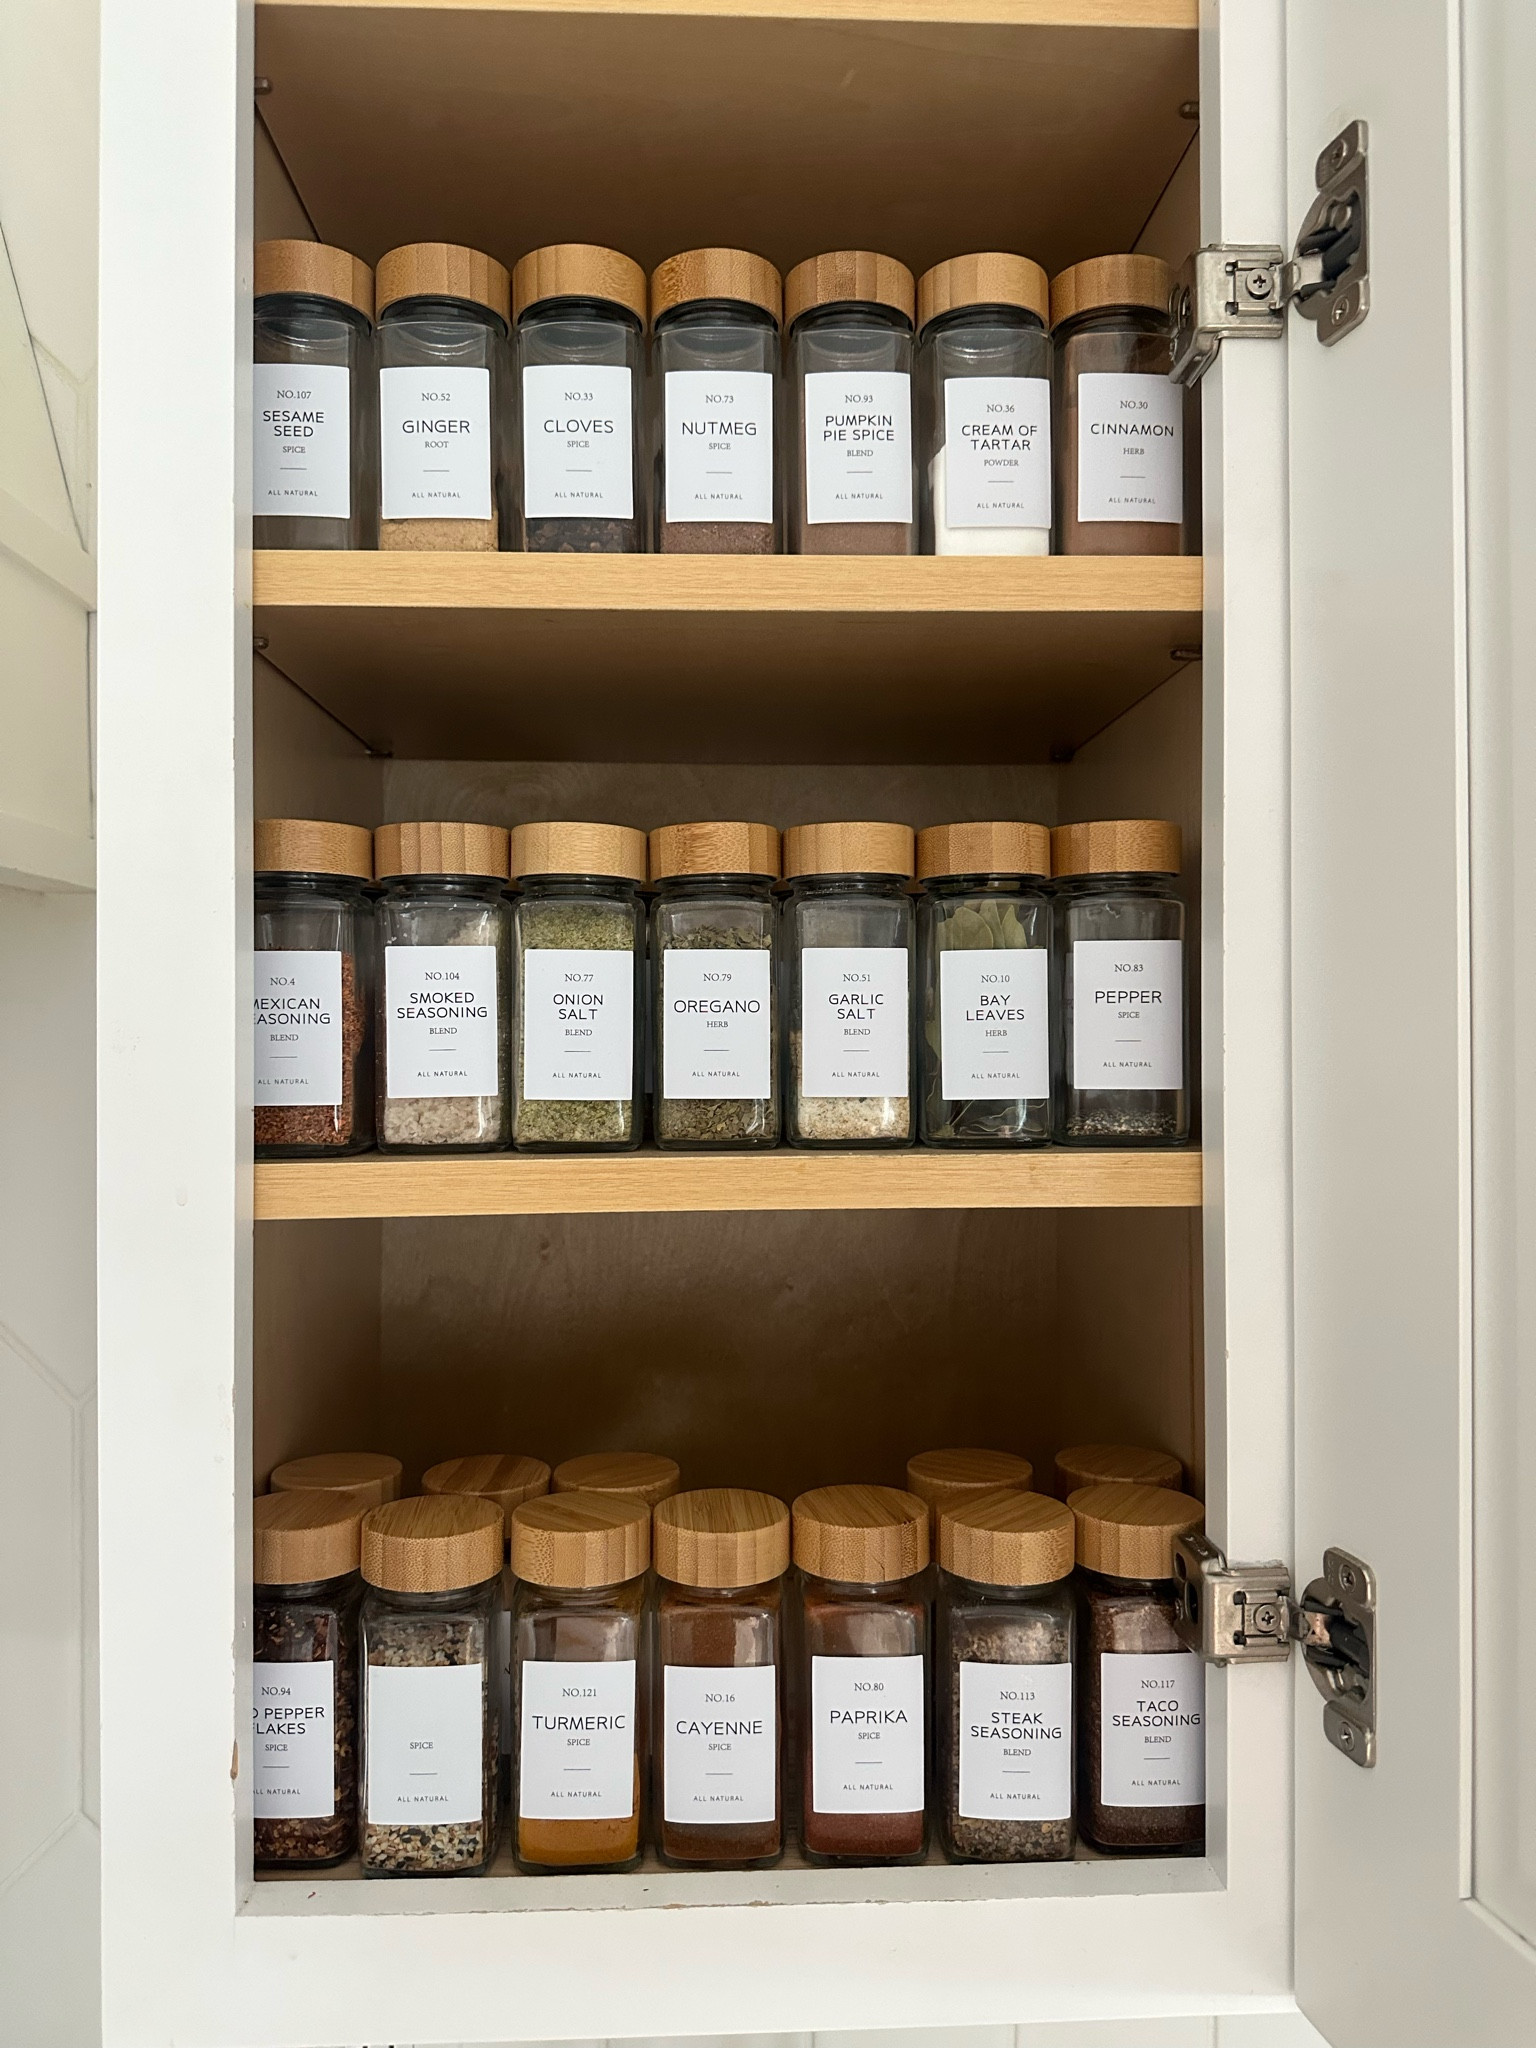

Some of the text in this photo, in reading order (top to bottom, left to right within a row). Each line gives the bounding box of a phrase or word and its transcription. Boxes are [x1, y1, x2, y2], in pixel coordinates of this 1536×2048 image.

[276, 390, 312, 400] NO.107
[421, 392, 451, 402] NO.52
[564, 391, 594, 402] NO.33
[705, 394, 735, 404] NO.73
[844, 394, 874, 404] NO.93
[986, 403, 1016, 414] NO.36
[1119, 400, 1149, 410] NO.30
[262, 410, 325, 424] SESAME
[825, 414, 893, 428] PUMPKIN
[273, 424, 314, 438] SEED
[401, 419, 471, 434] GINGER
[543, 418, 614, 434] CLOVES
[681, 421, 757, 436] NUTMEG
[961, 423, 1038, 437] CREAM OF
[1090, 422, 1174, 438] CINNAMON
[823, 428, 895, 442] PIE SPICE
[281, 445, 307, 454] SPICE
[424, 440, 450, 449] ROOT
[566, 440, 590, 449] SPICE
[708, 442, 732, 451] SPICE
[969, 438, 1031, 452] TARTAR
[846, 449, 874, 458] BLEND
[1122, 447, 1146, 456] HERB
[983, 458, 1020, 467] POWDER
[283, 489, 319, 497] NATURAL
[427, 491, 461, 499] NATURAL
[554, 491, 604, 499] ALL NATURAL
[710, 493, 743, 501] NATURAL
[850, 492, 883, 500] NATURAL
[992, 501, 1025, 509] NATURAL
[1123, 497, 1156, 505] NATURAL
[1113, 963, 1144, 973] NO.83
[424, 971, 460, 981] NO.104
[564, 973, 594, 983] NO.77
[703, 972, 732, 982] NO.79
[842, 973, 871, 983] NO.51
[980, 974, 1011, 984] NO.10
[269, 977, 296, 986] NO.4
[409, 991, 475, 1005] SMOKED
[552, 993, 604, 1006] ONION
[828, 993, 885, 1006] GARLIC
[980, 994, 1011, 1007] BAY
[1094, 990, 1163, 1005] PEPPER
[673, 999, 761, 1014] OREGANO
[396, 1006, 488, 1020] SEASONING
[558, 1008, 599, 1021] SALT
[836, 1007, 877, 1020] SALT
[965, 1008, 1025, 1022] LEAVES
[1117, 1011, 1141, 1019] SPICE
[706, 1020, 729, 1029] HERB
[428, 1026, 458, 1035] BLEND
[564, 1028, 593, 1037] BLEND
[843, 1028, 871, 1036] BLEND
[985, 1029, 1008, 1038] HERB
[269, 1033, 300, 1042] BLEND
[707, 1070, 741, 1078] NATURAL
[257, 1078, 272, 1086] ALL
[853, 1682, 885, 1692] NO.80
[1140, 1679, 1176, 1689] NO.117
[260, 1686, 292, 1696] NO.94
[561, 1687, 597, 1698] NO.121
[999, 1690, 1036, 1701] NO.113
[704, 1693, 736, 1703] NO.16
[1135, 1699, 1179, 1713] TACO
[264, 1706, 326, 1720] PEPPER
[830, 1709, 909, 1725] PAPRIKA
[991, 1711, 1044, 1725] STEAK
[531, 1714, 626, 1731] TURMERIC
[1112, 1713, 1202, 1728] SEASONING
[253, 1722, 306, 1736] LAKES
[675, 1720, 763, 1736] CAYENNE
[970, 1725, 1062, 1740] SEASONING
[857, 1731, 881, 1740] SPICE
[1144, 1735, 1172, 1744] BLEND
[409, 1741, 434, 1750] SPICE
[566, 1737, 591, 1747] SPICE
[264, 1743, 289, 1752] SPICE
[707, 1743, 732, 1752] SPICE
[1002, 1748, 1032, 1757] BLEND
[266, 1788, 302, 1796] NATURAL
[859, 1783, 894, 1791] NATURAL
[396, 1795, 449, 1803] ALL NATURAL
[693, 1795, 707, 1803] ALL
[989, 1792, 1004, 1800] ALL
